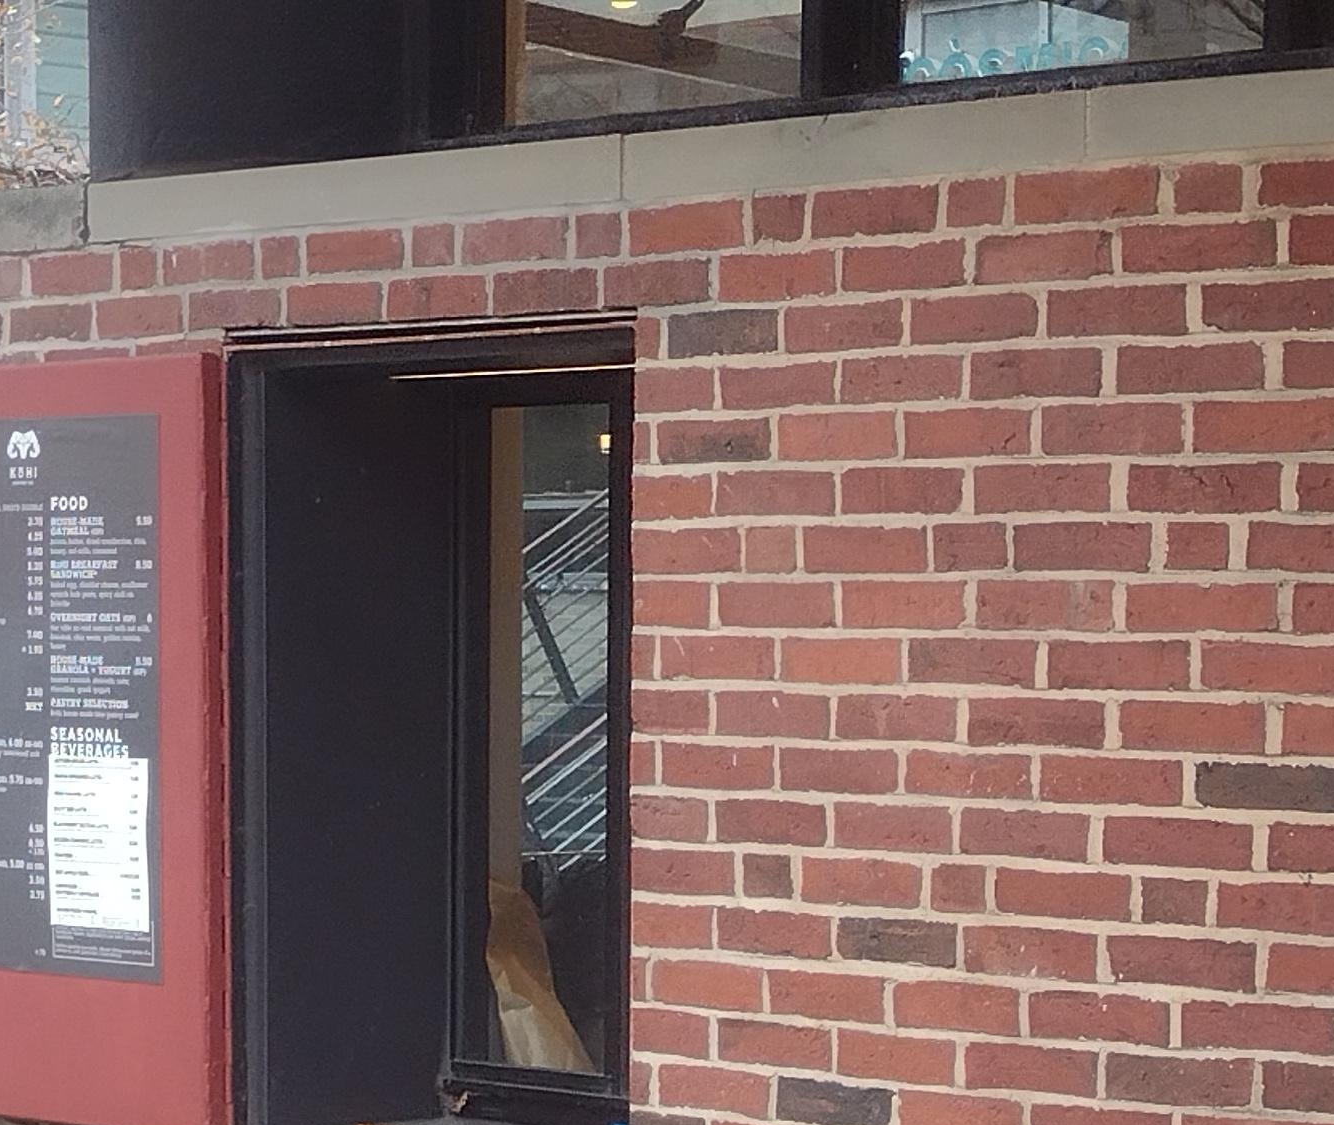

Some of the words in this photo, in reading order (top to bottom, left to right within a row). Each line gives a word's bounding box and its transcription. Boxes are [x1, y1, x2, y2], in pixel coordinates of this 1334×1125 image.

[50, 495, 88, 511] FOOD
[50, 726, 122, 743] SEASONAL
[50, 742, 129, 758] BEVERAGES
